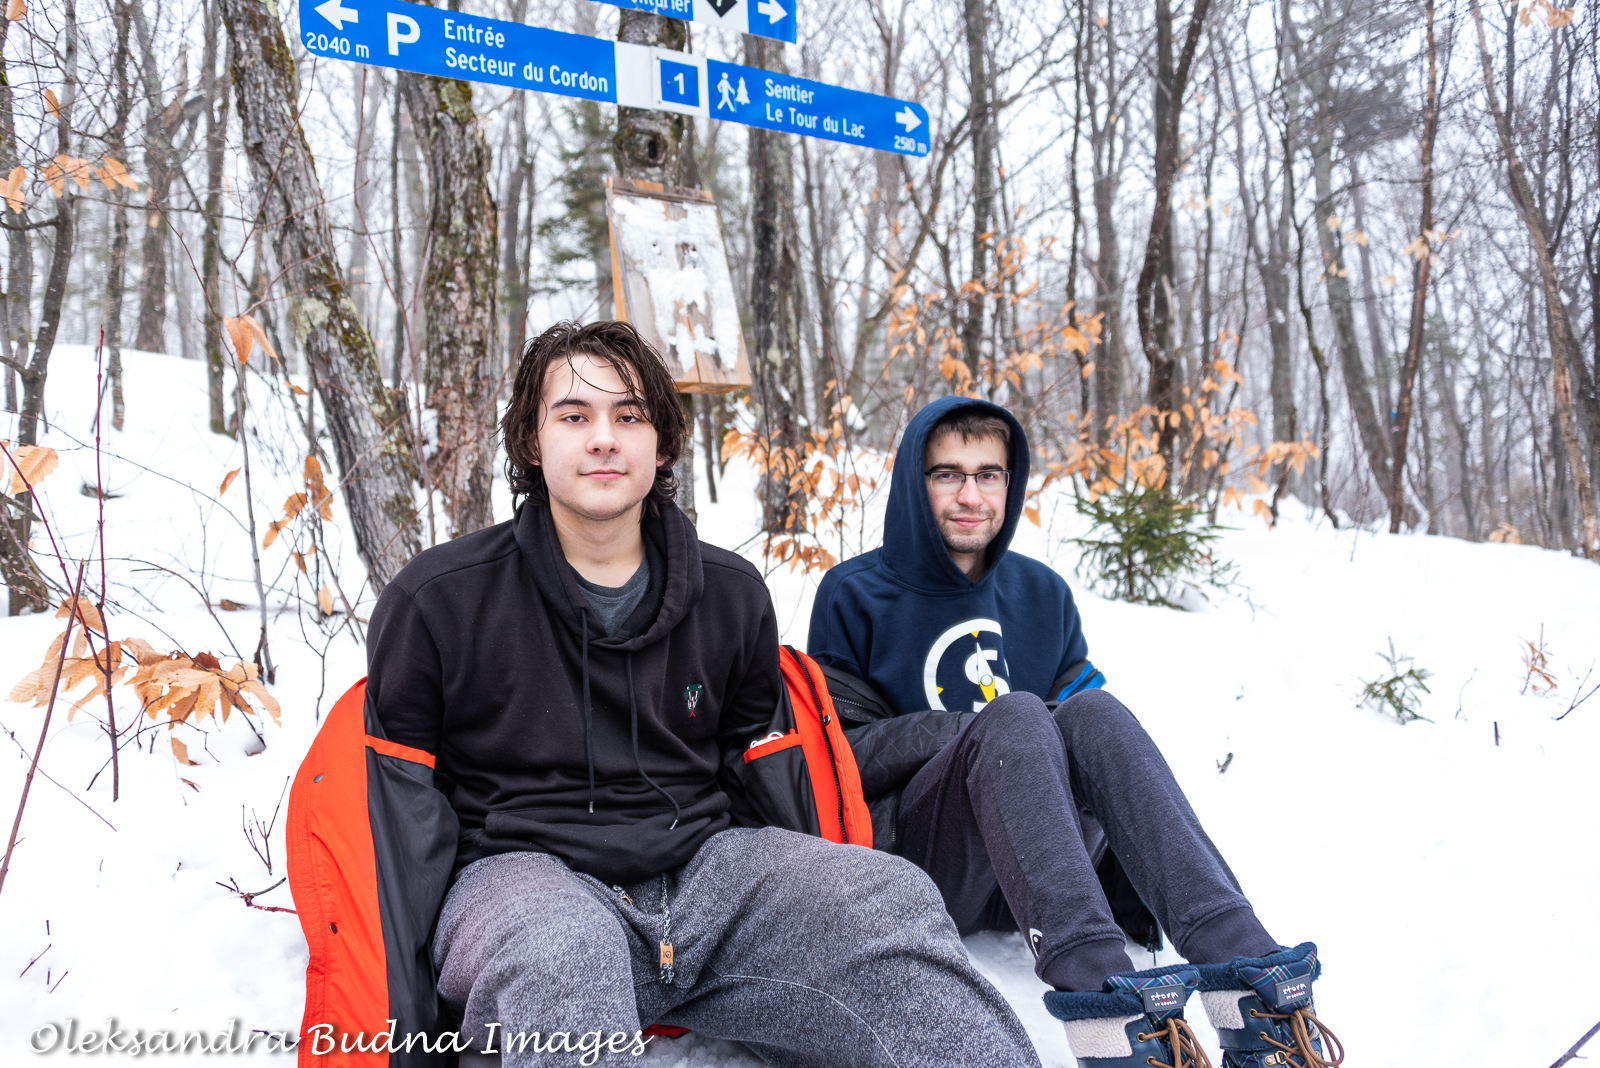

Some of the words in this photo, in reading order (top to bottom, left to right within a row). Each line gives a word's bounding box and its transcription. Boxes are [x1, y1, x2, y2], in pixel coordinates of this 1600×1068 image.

[305, 32, 351, 56] 2040
[355, 43, 370, 59] m
[387, 12, 420, 56] P
[444, 18, 505, 49] Entrée
[445, 47, 516, 77] Secteur
[523, 61, 544, 83] du
[549, 65, 608, 93] Cordon
[673, 72, 685, 95] 1
[765, 78, 815, 105] Sentier
[765, 102, 783, 123] Le
[788, 107, 818, 129] Tour
[823, 115, 839, 134] du
[842, 118, 865, 139] Lac
[894, 135, 916, 152] 2510
[917, 142, 927, 154] m
[1150, 991, 1179, 1002] storm
[1283, 983, 1307, 995] storm
